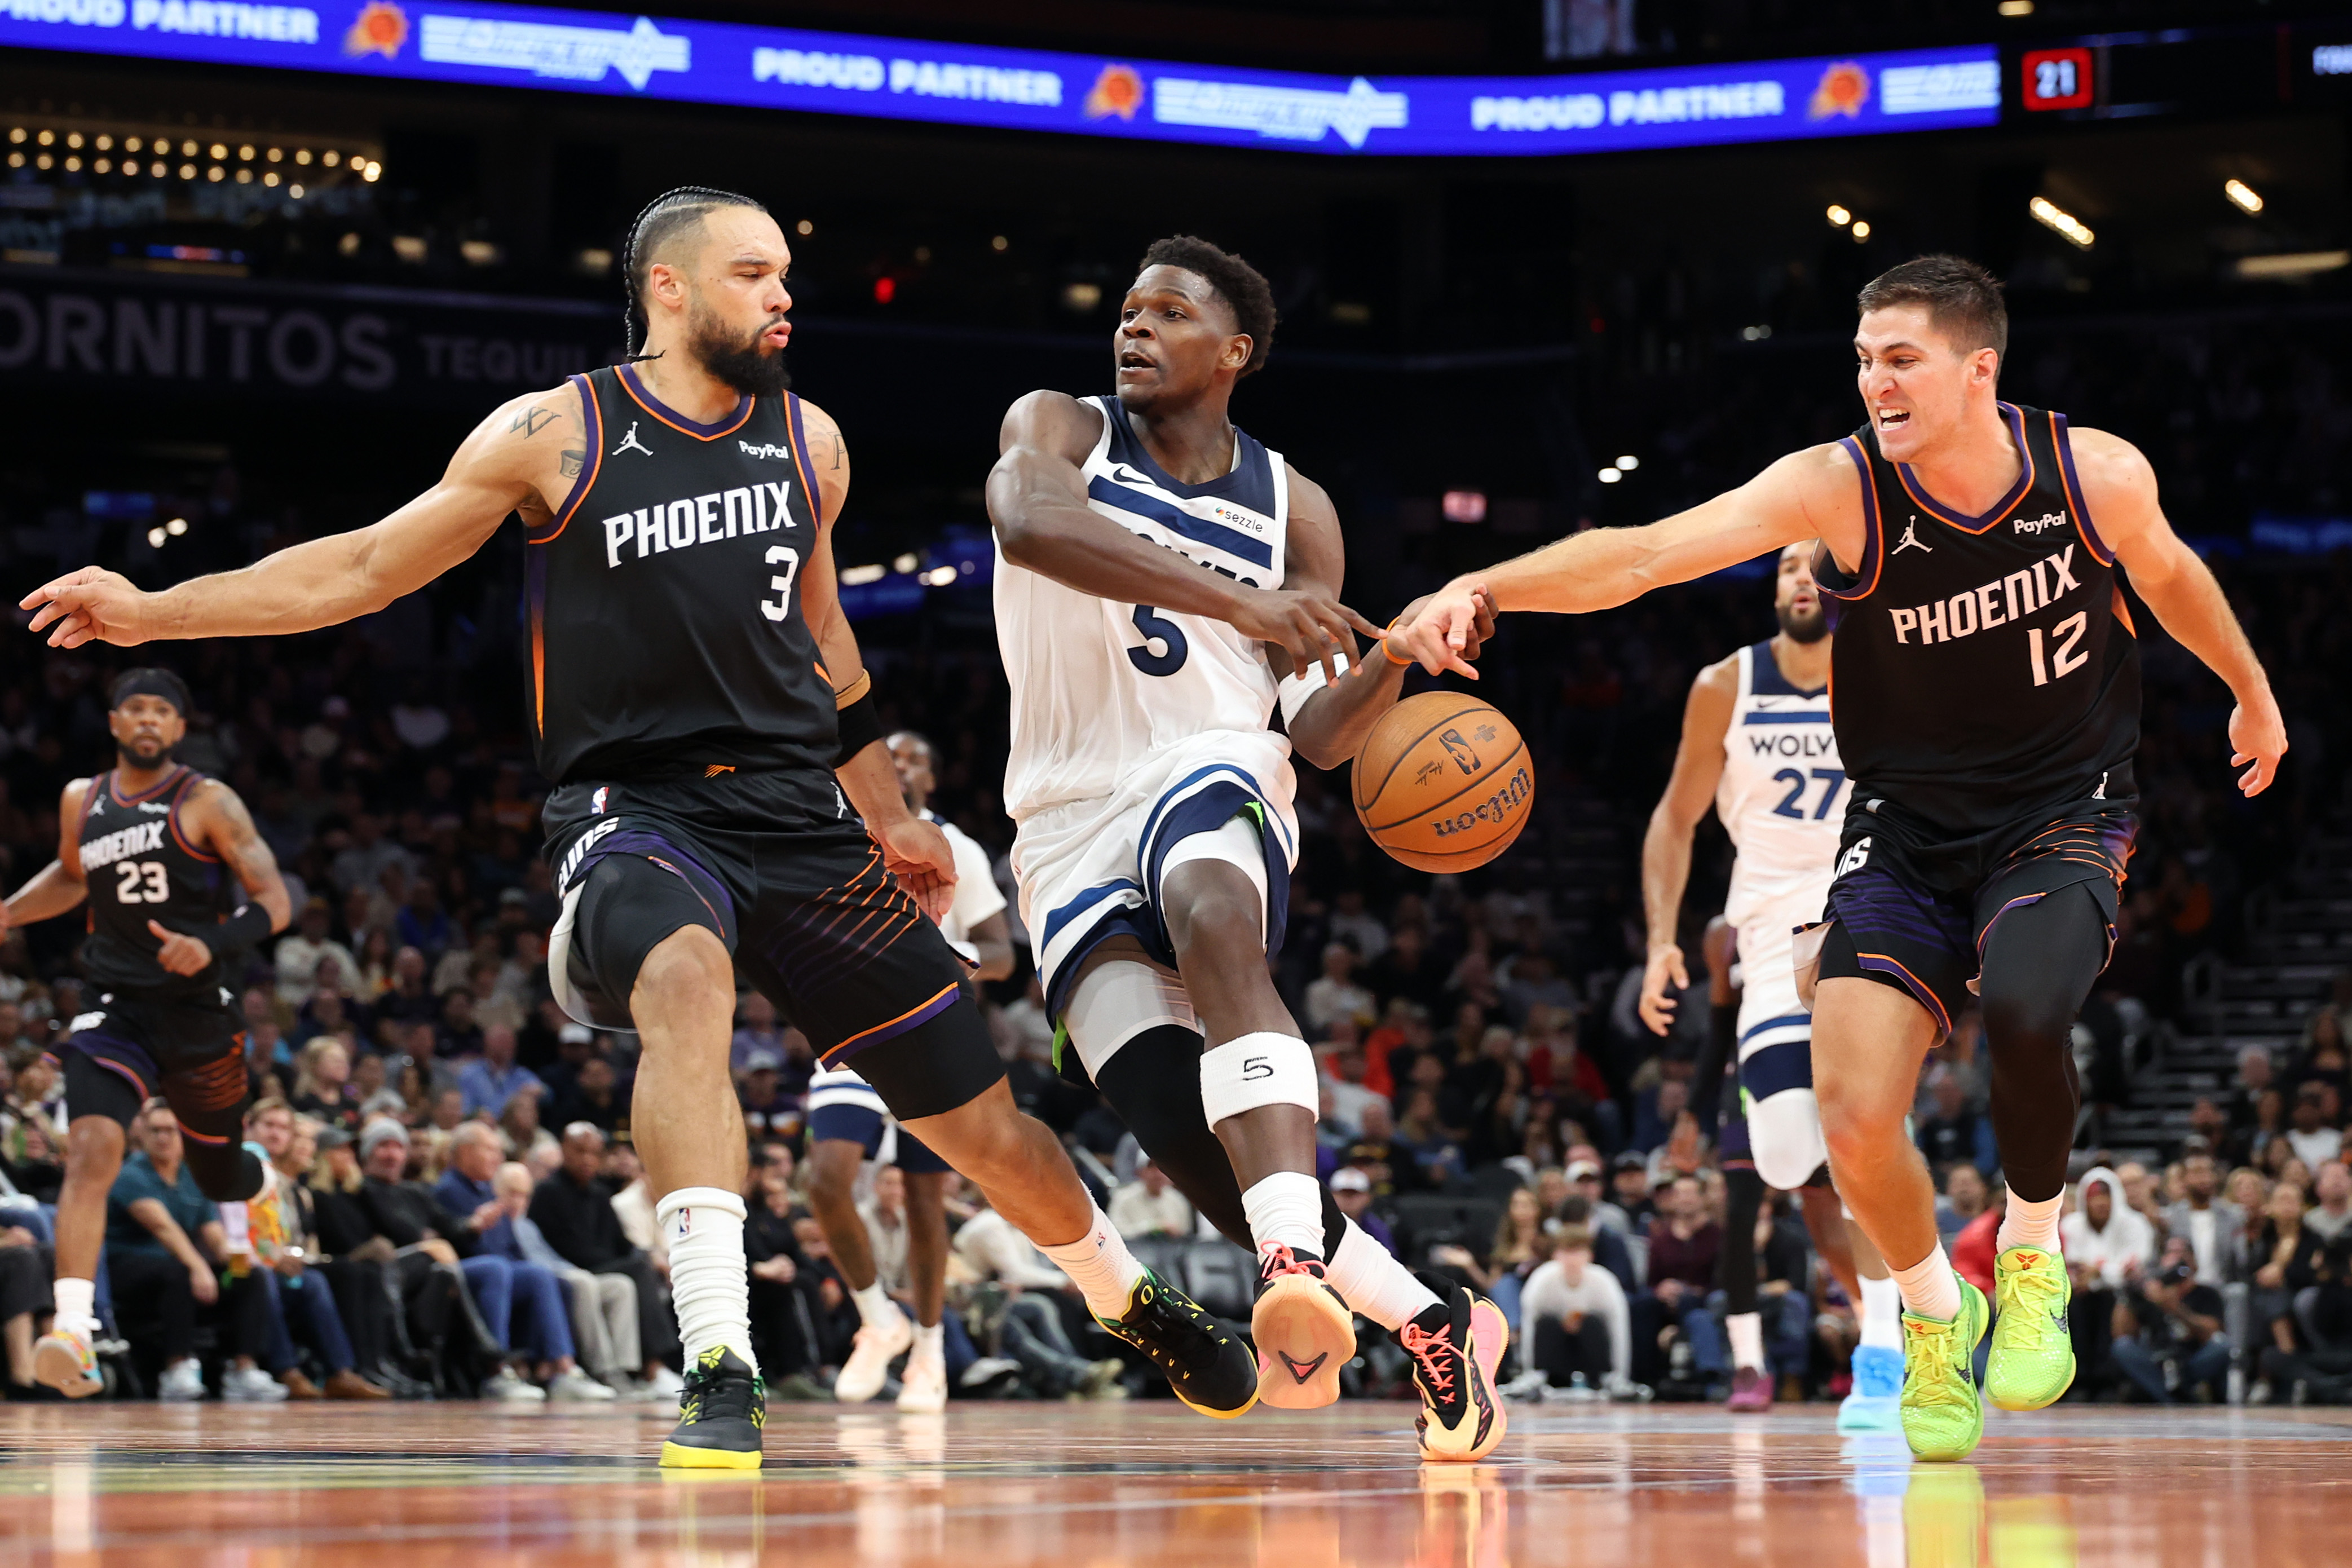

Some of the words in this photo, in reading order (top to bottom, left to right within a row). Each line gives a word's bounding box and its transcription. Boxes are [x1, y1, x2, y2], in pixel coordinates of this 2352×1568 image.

[0, 0, 125, 28] ROUD
[131, 0, 320, 45] PARTNER
[752, 46, 885, 92] PROUD
[889, 58, 1063, 107] PARTNER
[2035, 60, 2076, 99] 21
[1471, 92, 1605, 132] PROUD
[1609, 79, 1785, 127] PARTNER
[739, 440, 789, 460] PayPal
[602, 480, 797, 568] PHOENIX
[1225, 509, 1263, 533] sezzle
[2013, 510, 2067, 535] PayPal
[761, 545, 800, 621] 3
[1888, 543, 2081, 644] PHOENIX
[1127, 604, 1188, 677] 5
[2027, 611, 2089, 687] 12
[1749, 735, 1839, 756] WOLV
[1772, 768, 1846, 820] 27
[116, 861, 169, 904] 23
[1242, 1056, 1274, 1081] 5
